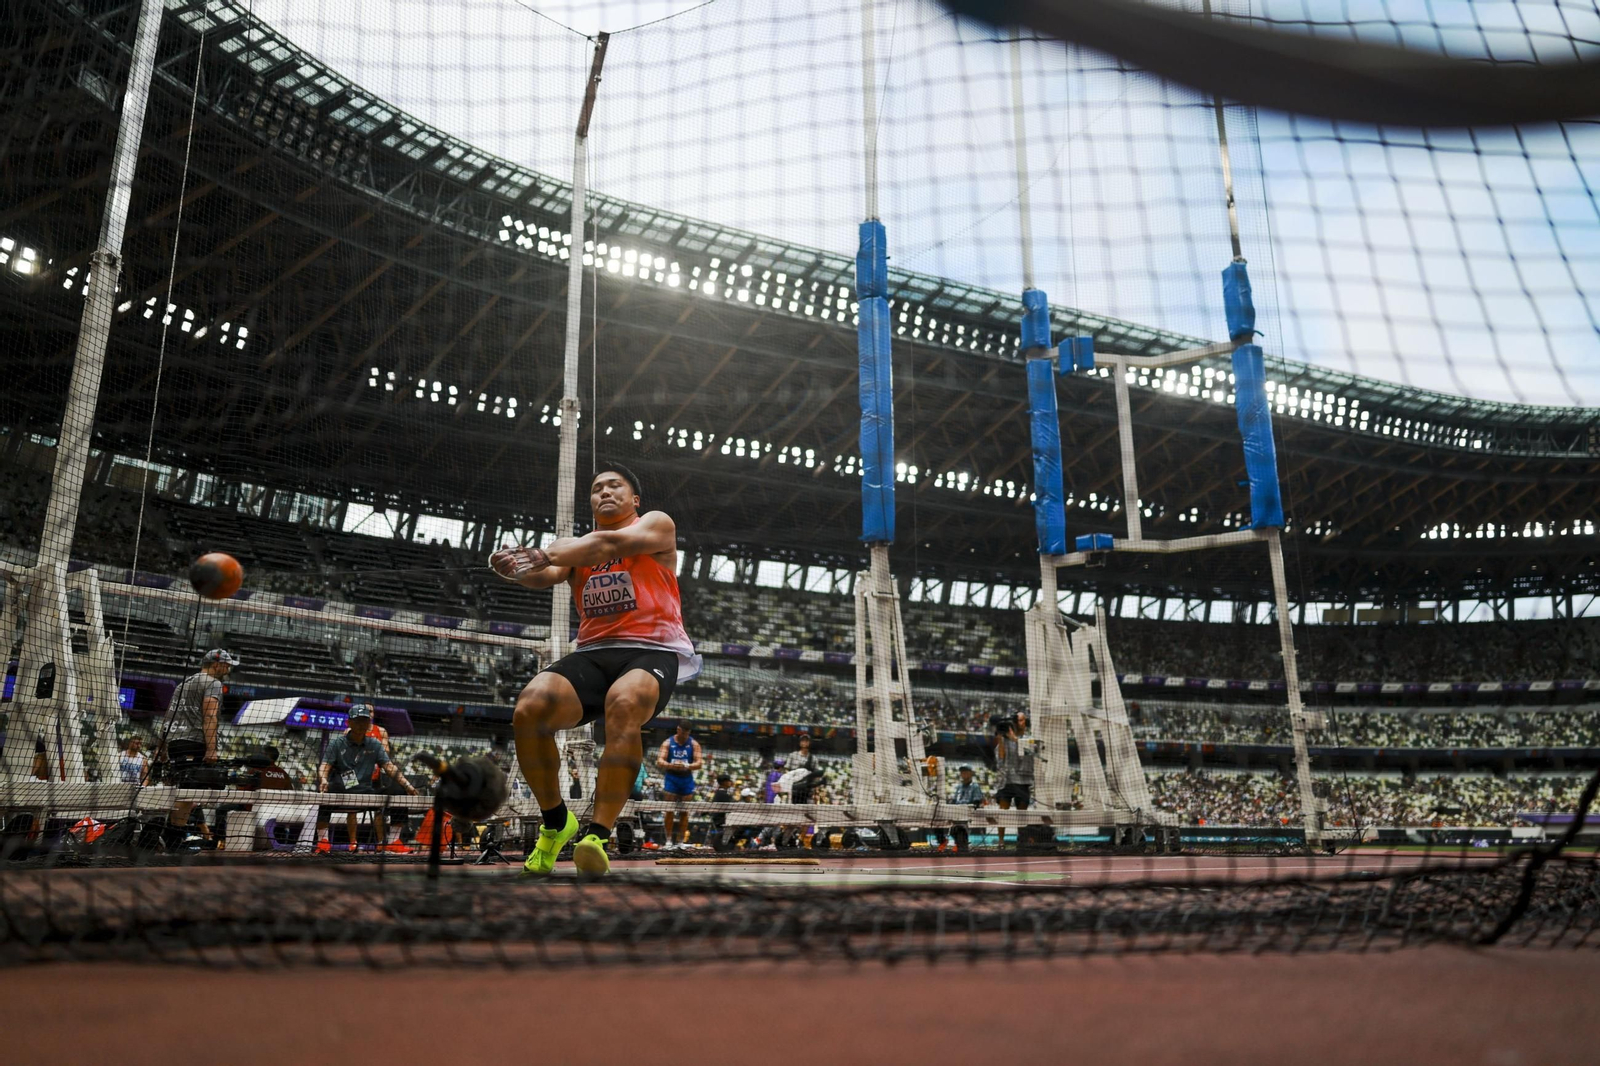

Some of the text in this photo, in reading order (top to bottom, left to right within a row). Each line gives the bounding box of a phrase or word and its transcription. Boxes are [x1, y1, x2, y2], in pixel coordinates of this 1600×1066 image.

[590, 573, 628, 589] TDK
[584, 587, 632, 606] FUKUDA
[673, 749, 688, 758] USA
